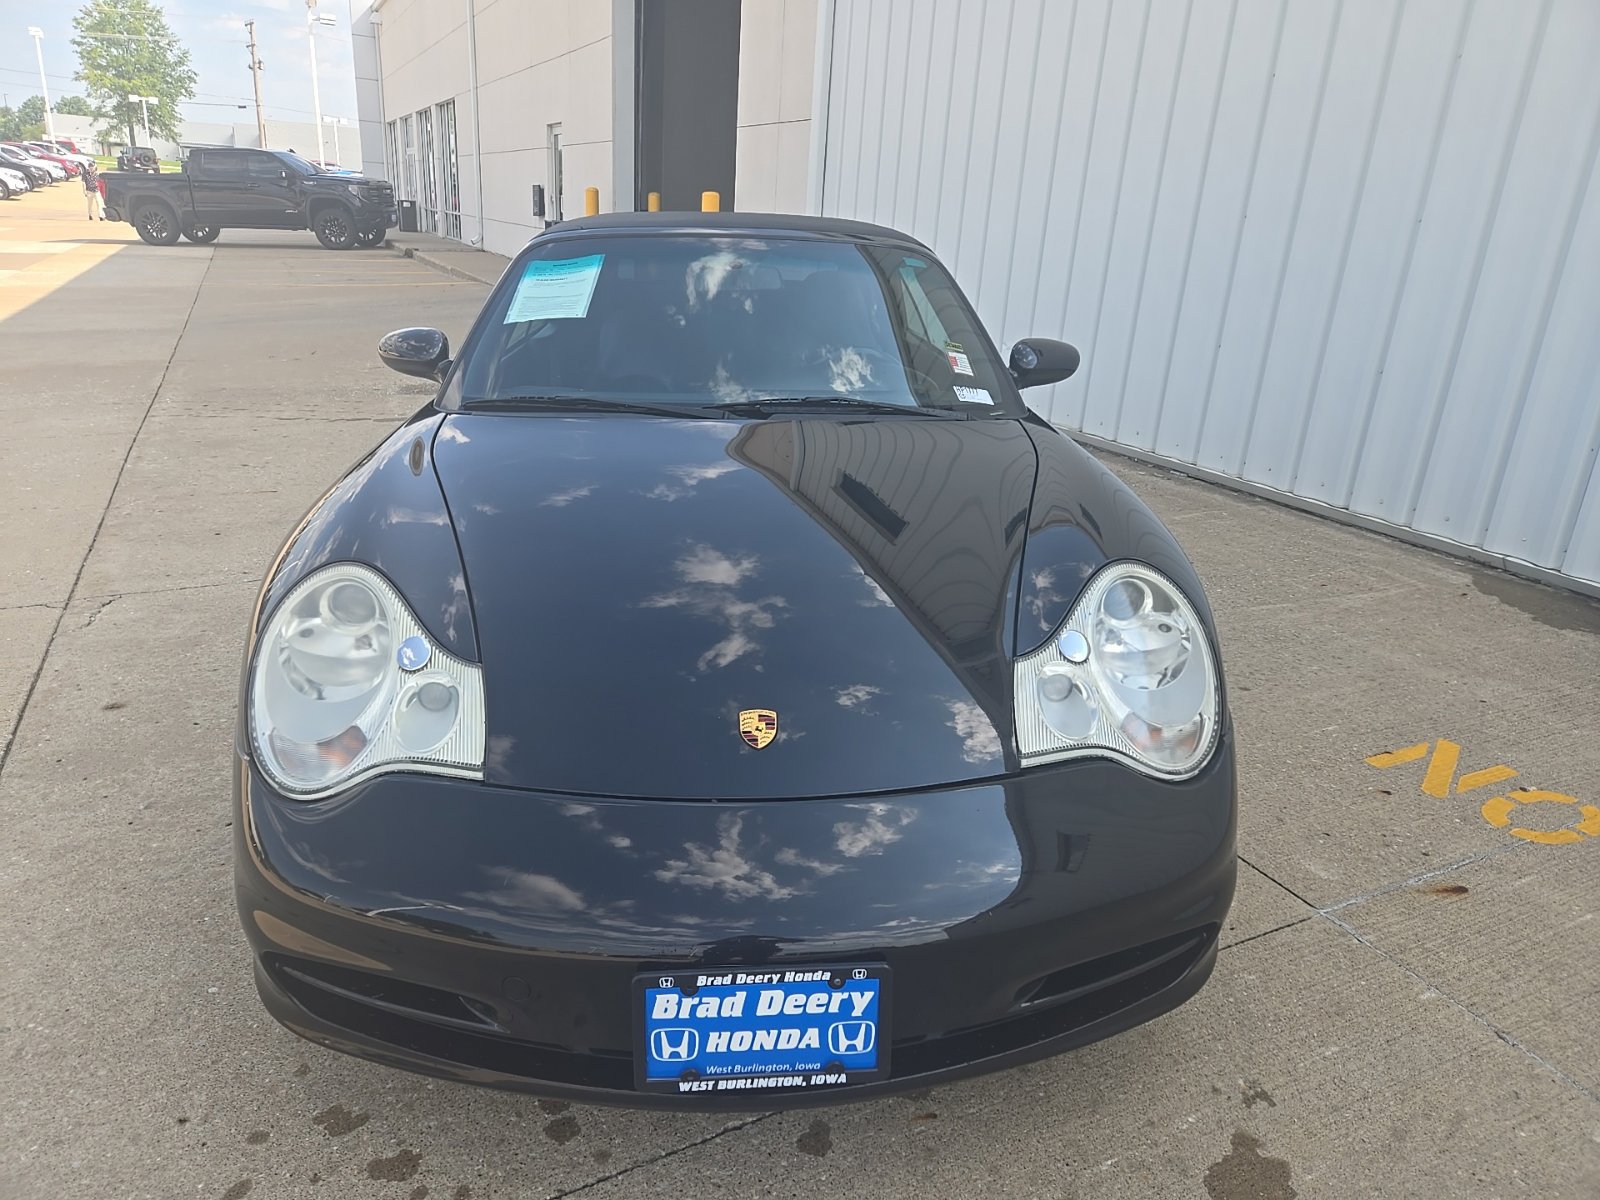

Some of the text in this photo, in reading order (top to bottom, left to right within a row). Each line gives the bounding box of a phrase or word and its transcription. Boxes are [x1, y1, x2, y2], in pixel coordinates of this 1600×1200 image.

[697, 970, 831, 987] Brad Deery Honda
[652, 989, 874, 1019] Brad Deery
[706, 1028, 820, 1053] HONDA
[706, 1061, 821, 1074] West Burlington, Iowa
[679, 1073, 847, 1092] WEST BURLINGTON, IOWA
